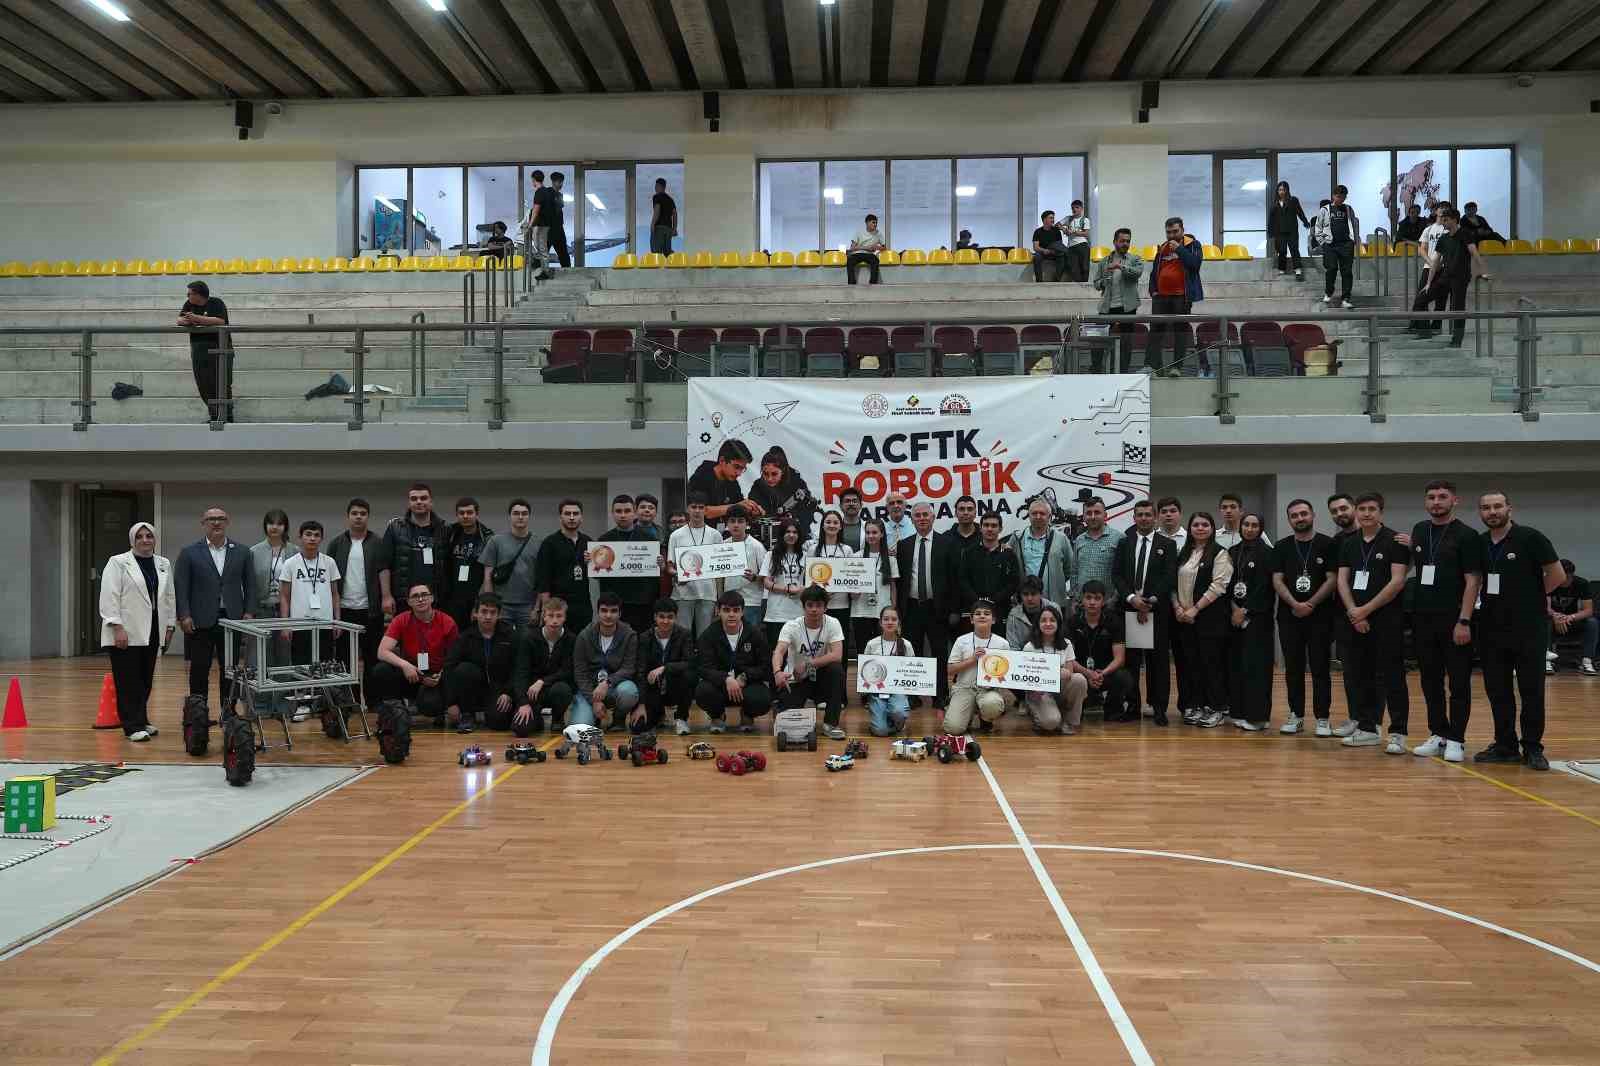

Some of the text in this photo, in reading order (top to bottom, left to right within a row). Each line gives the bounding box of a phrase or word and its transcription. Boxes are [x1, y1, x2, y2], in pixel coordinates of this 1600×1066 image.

[855, 428, 982, 465] ACFTK
[620, 562, 643, 570] 5.000
[709, 563, 731, 571] 7.500
[296, 568, 326, 579] ACF
[833, 578, 859, 586] 10.000
[1011, 673, 1041, 683] 10.000
[893, 679, 917, 688] 7.500
